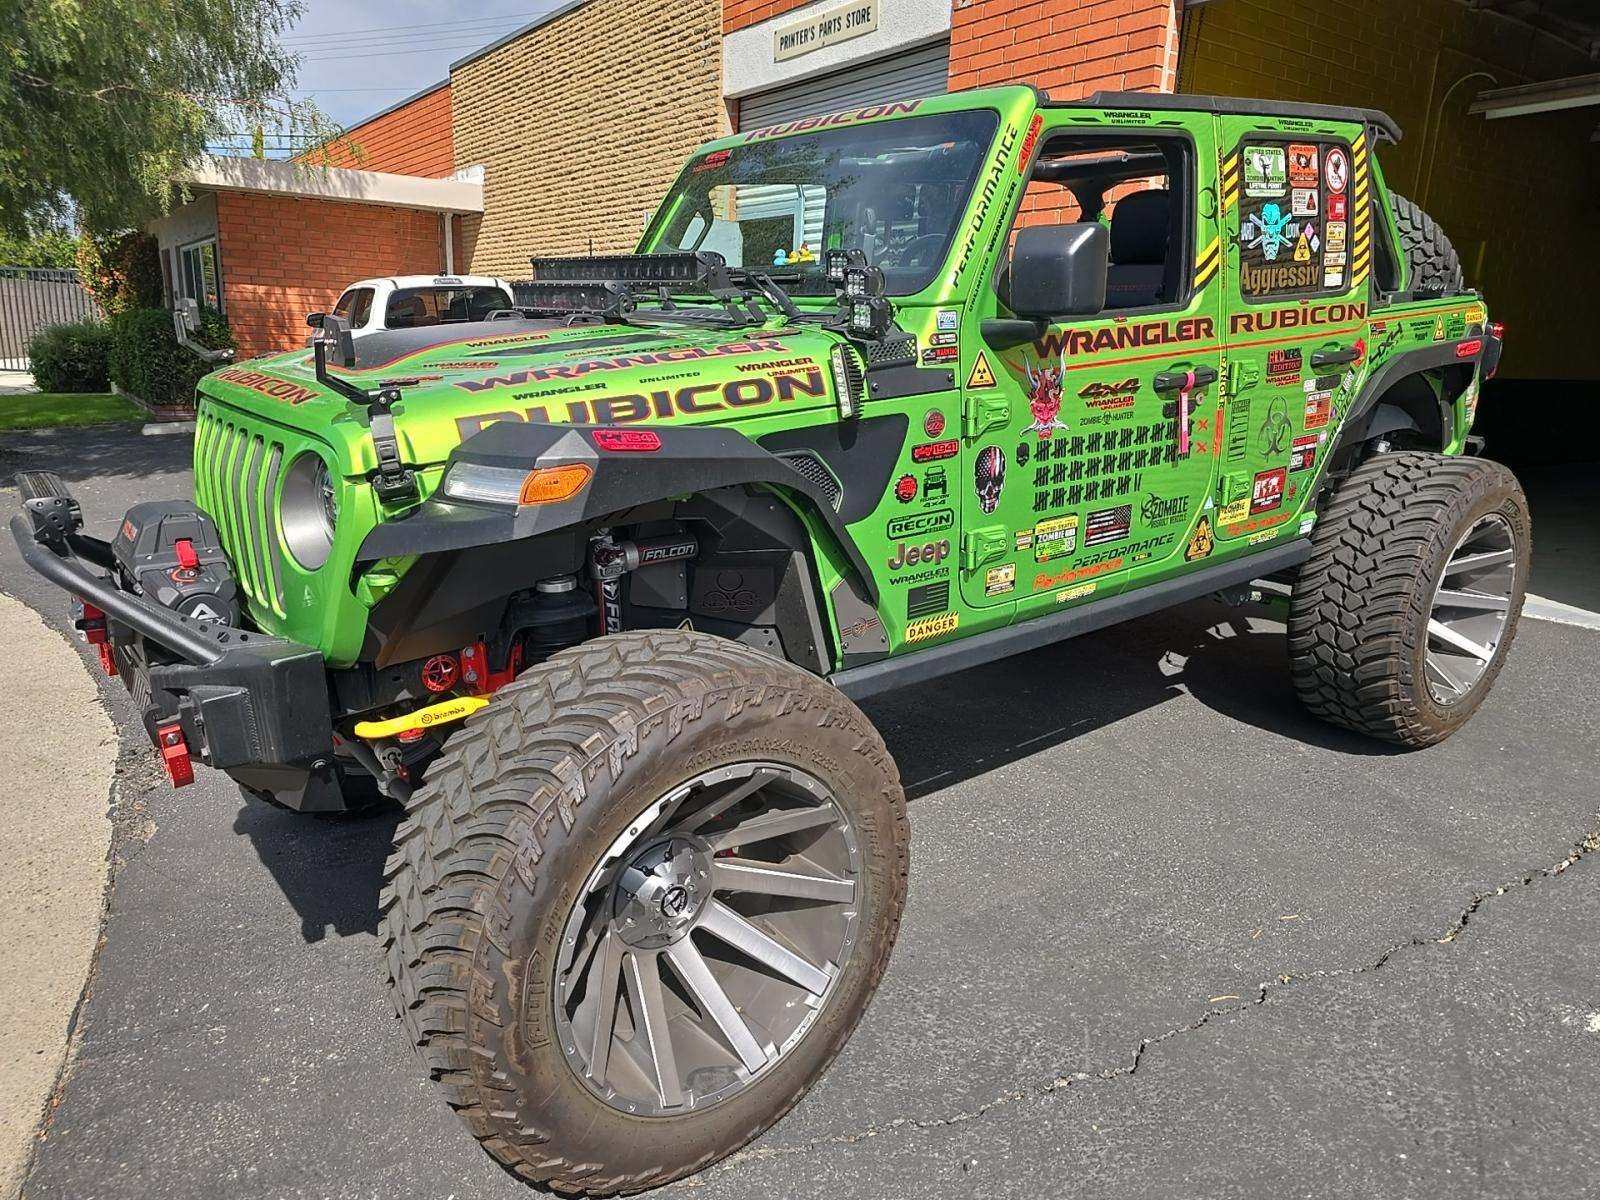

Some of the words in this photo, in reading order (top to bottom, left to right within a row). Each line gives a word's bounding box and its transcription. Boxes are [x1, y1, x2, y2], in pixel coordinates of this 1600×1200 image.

[779, 25, 815, 51] PRINTER'S
[819, 15, 842, 38] PARTS
[846, 6, 871, 29] STORE
[744, 100, 922, 142] RUBICON
[1104, 111, 1151, 119] WRANGLER
[1278, 119, 1313, 127] WRANGLER
[951, 122, 1018, 289] PERFORMANCE
[987, 180, 1017, 253] WRANGLER
[1230, 302, 1366, 334] RUBICON
[465, 334, 550, 348] WRANGLER
[1033, 317, 1214, 359] WRANGLER
[453, 339, 790, 392] WRANGLER
[734, 357, 814, 373] WRANGLER
[767, 365, 821, 378] UNLIMITED
[216, 368, 322, 406] RUBICON
[639, 371, 700, 384] UNLIMITED
[1219, 356, 1227, 409] DANGER
[512, 382, 608, 401] WRANGLER
[1085, 395, 1134, 408] WRANGLER
[1101, 402, 1135, 411] UNLIMITED
[1080, 415, 1102, 426] ZOMBIE
[1112, 411, 1135, 421] HUNTER
[934, 443, 957, 455] 1941
[1152, 494, 1190, 519] ZOMBIE
[892, 513, 950, 533] RECON
[1038, 529, 1065, 543] ZOMBIE
[645, 544, 695, 561] FALCON
[888, 539, 950, 570] Jeep
[1073, 532, 1175, 570] PERFORMANCE
[889, 567, 950, 586] WRANGLER
[909, 618, 955, 638] DANGER
[434, 706, 466, 721] brembo
